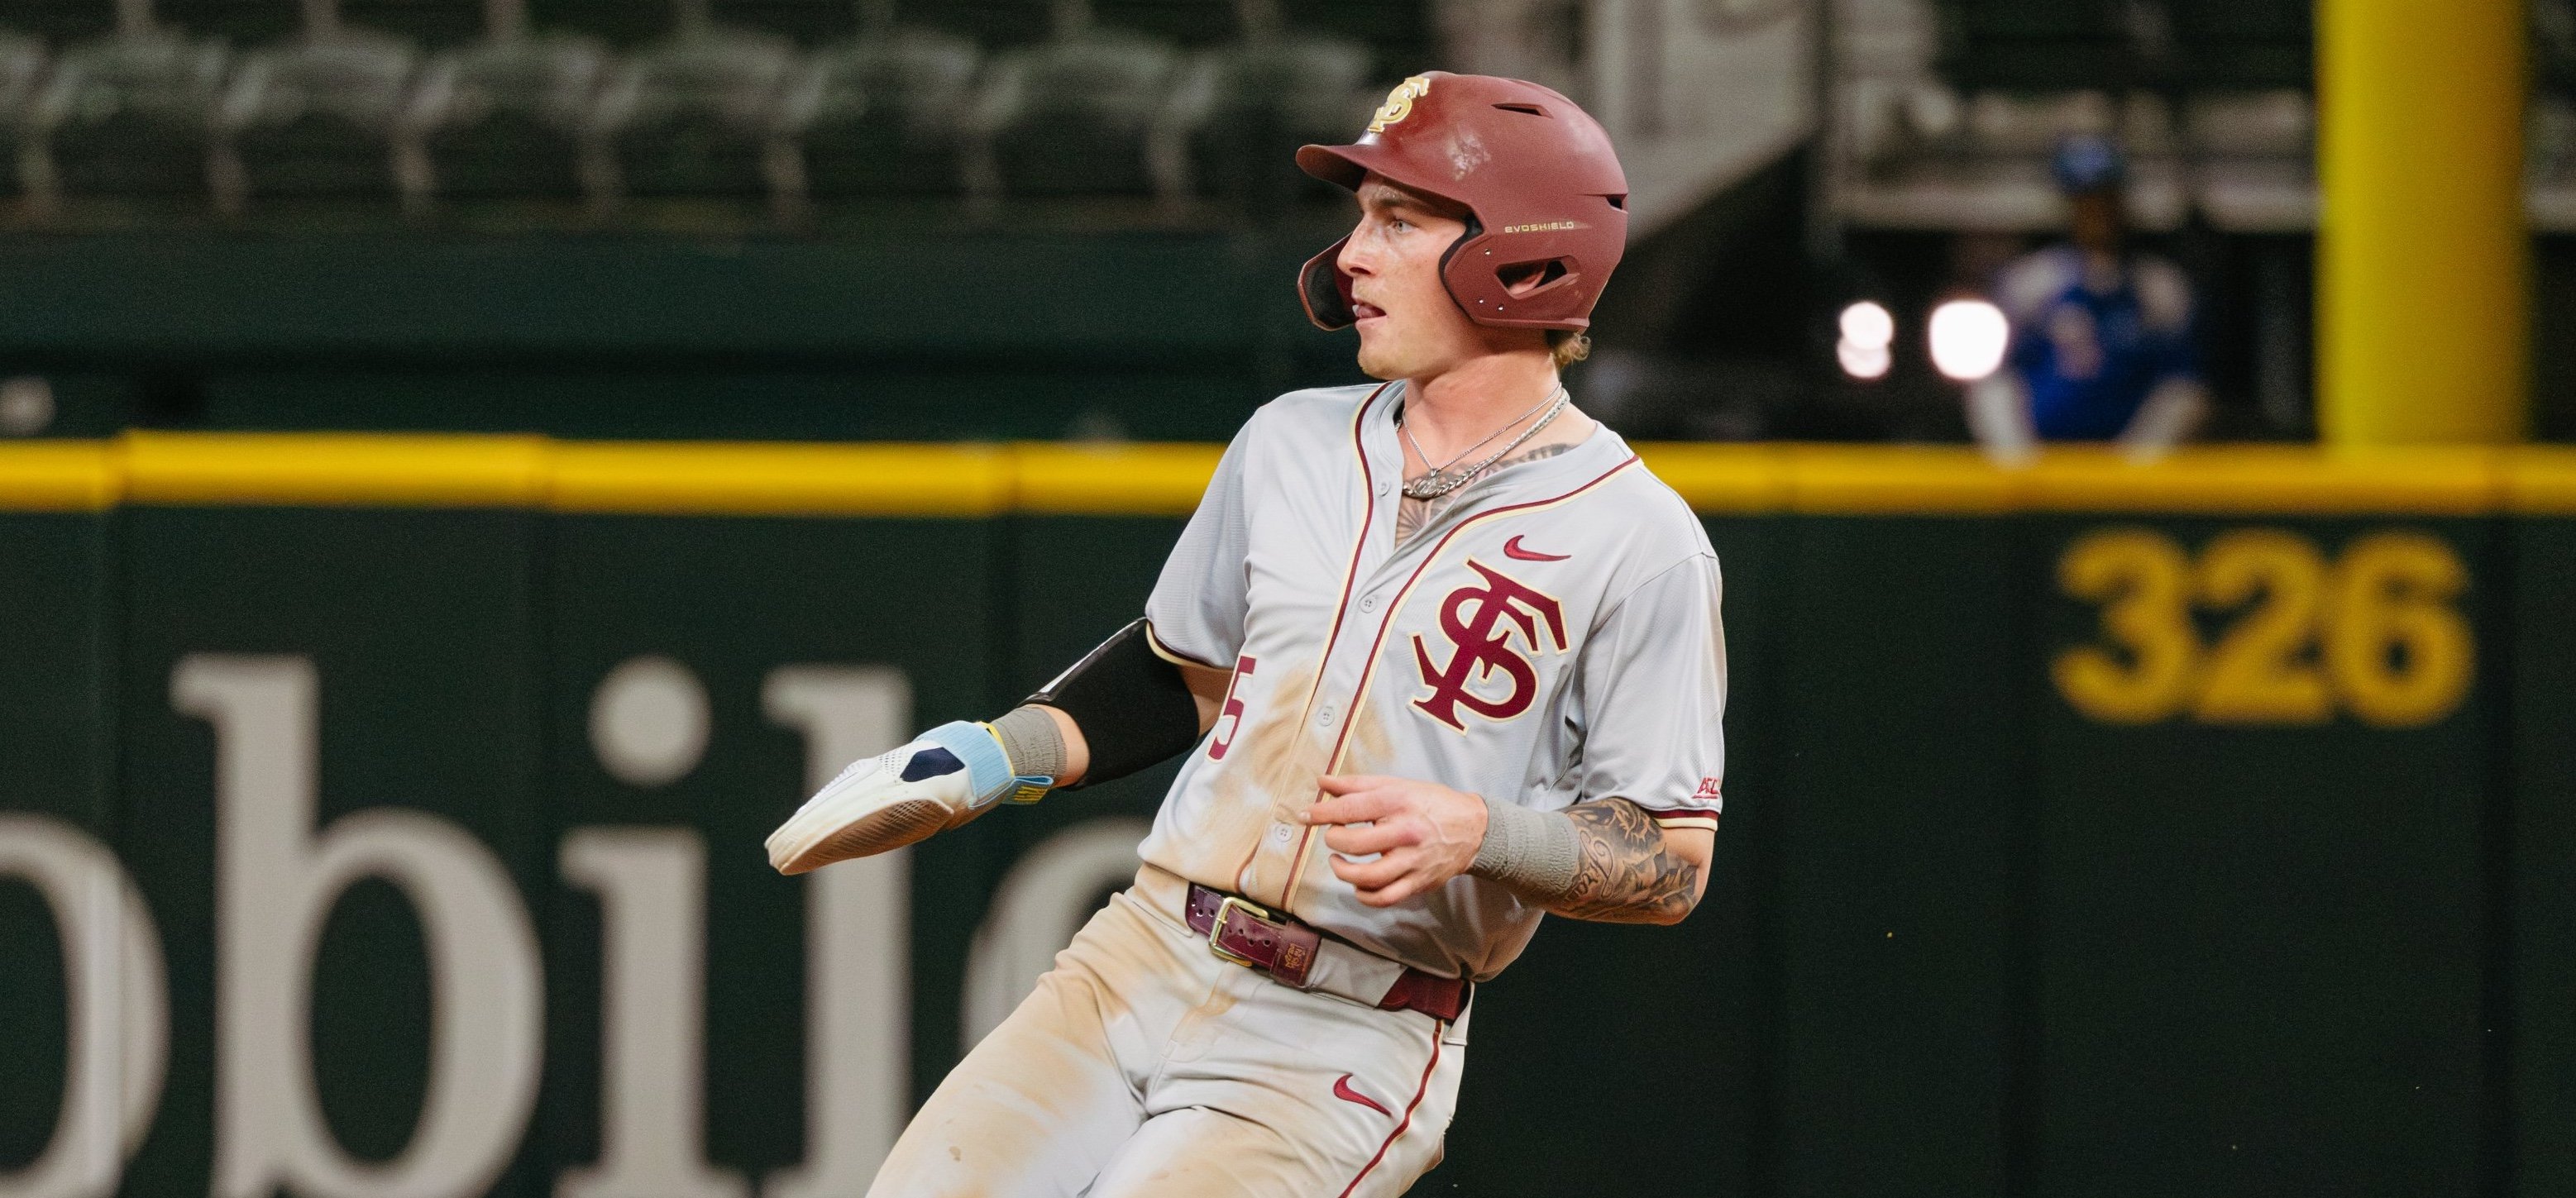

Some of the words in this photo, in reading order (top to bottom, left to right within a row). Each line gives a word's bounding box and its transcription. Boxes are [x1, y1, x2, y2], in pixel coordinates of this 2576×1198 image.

[1504, 221, 1575, 233] EVOSHIELD
[2055, 530, 2474, 725] 326
[1206, 653, 1257, 762] 5
